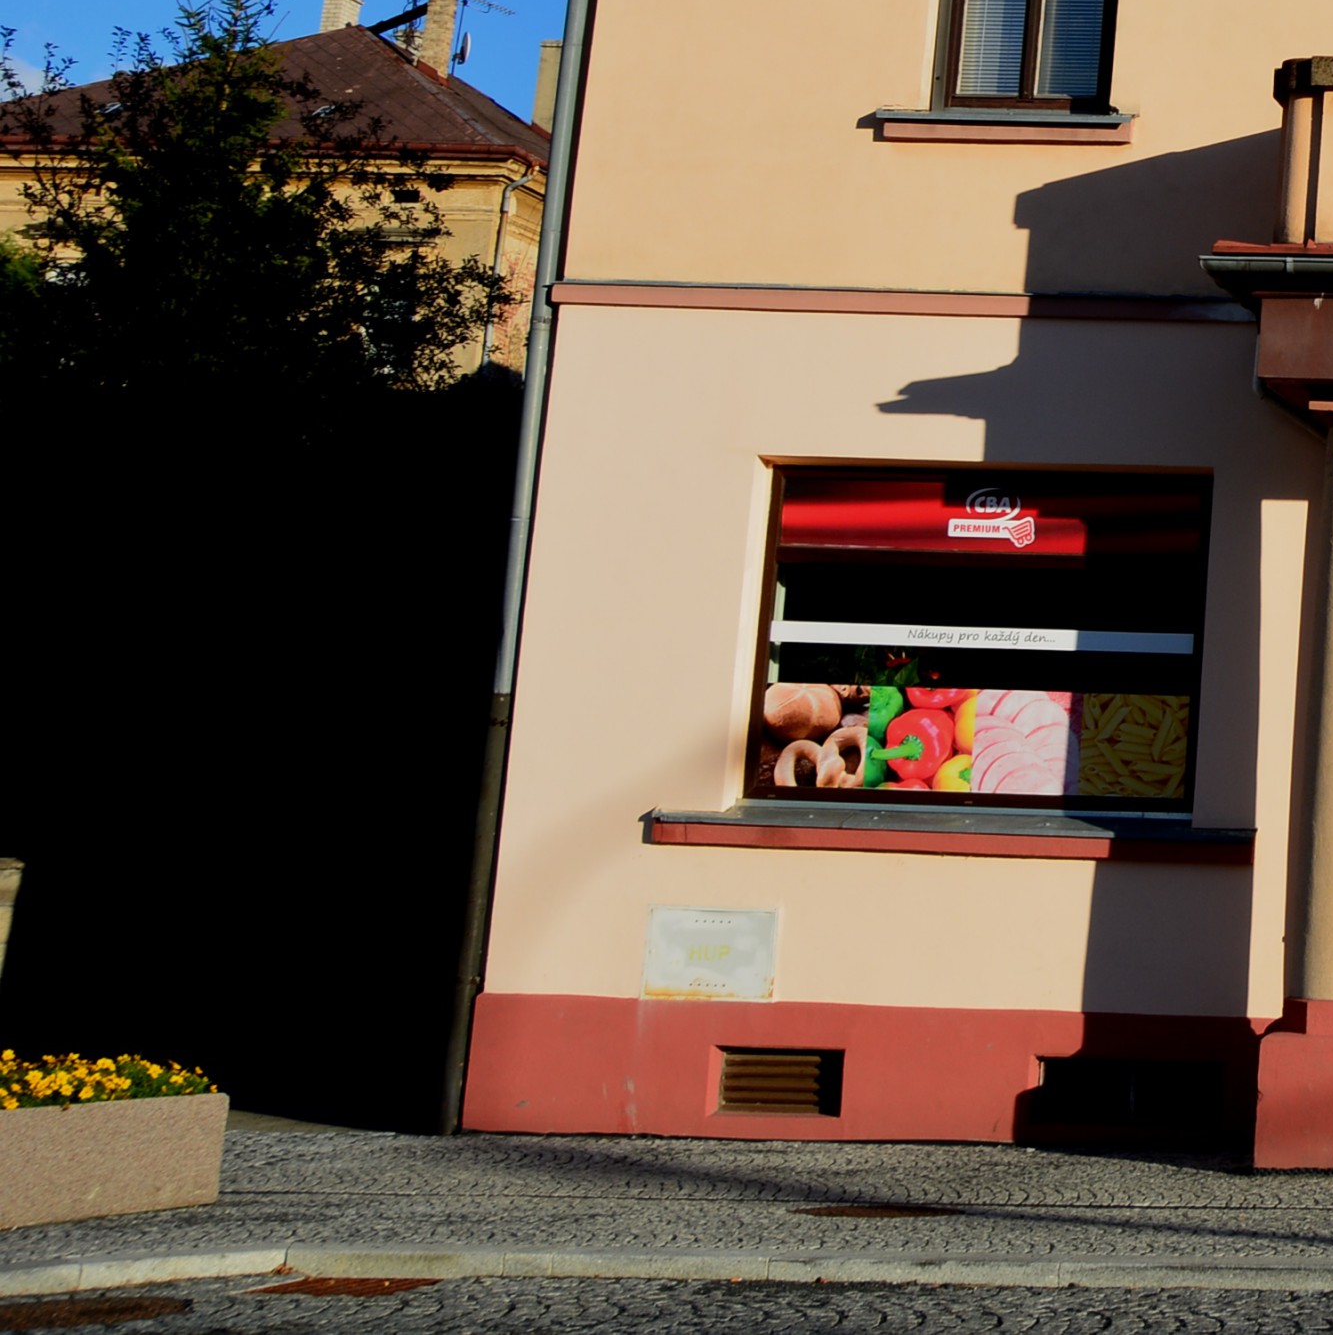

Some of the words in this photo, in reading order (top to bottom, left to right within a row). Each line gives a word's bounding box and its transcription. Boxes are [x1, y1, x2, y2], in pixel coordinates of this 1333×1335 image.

[973, 496, 1013, 514] CBA
[953, 523, 1001, 534] PREMIUM
[907, 629, 954, 644] Nákupy
[957, 631, 980, 644] pro
[984, 630, 1020, 645] každý
[1024, 631, 1056, 643] den...
[688, 944, 733, 962] HUP
